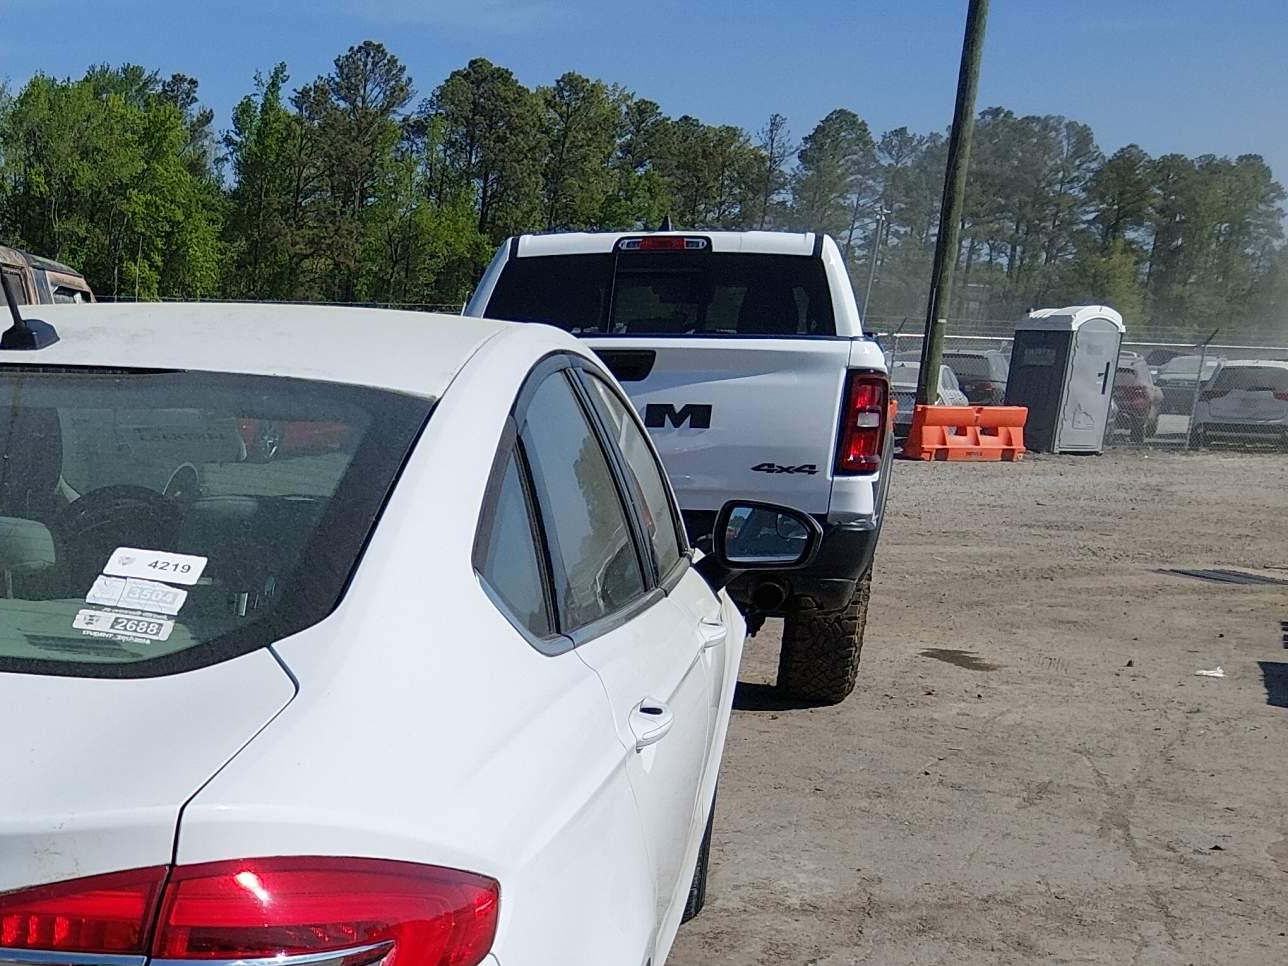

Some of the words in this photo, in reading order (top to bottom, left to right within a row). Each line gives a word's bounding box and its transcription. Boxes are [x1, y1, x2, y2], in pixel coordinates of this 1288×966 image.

[751, 463, 819, 475] 4x4
[148, 559, 192, 574] 4219
[114, 618, 159, 635] 2688
